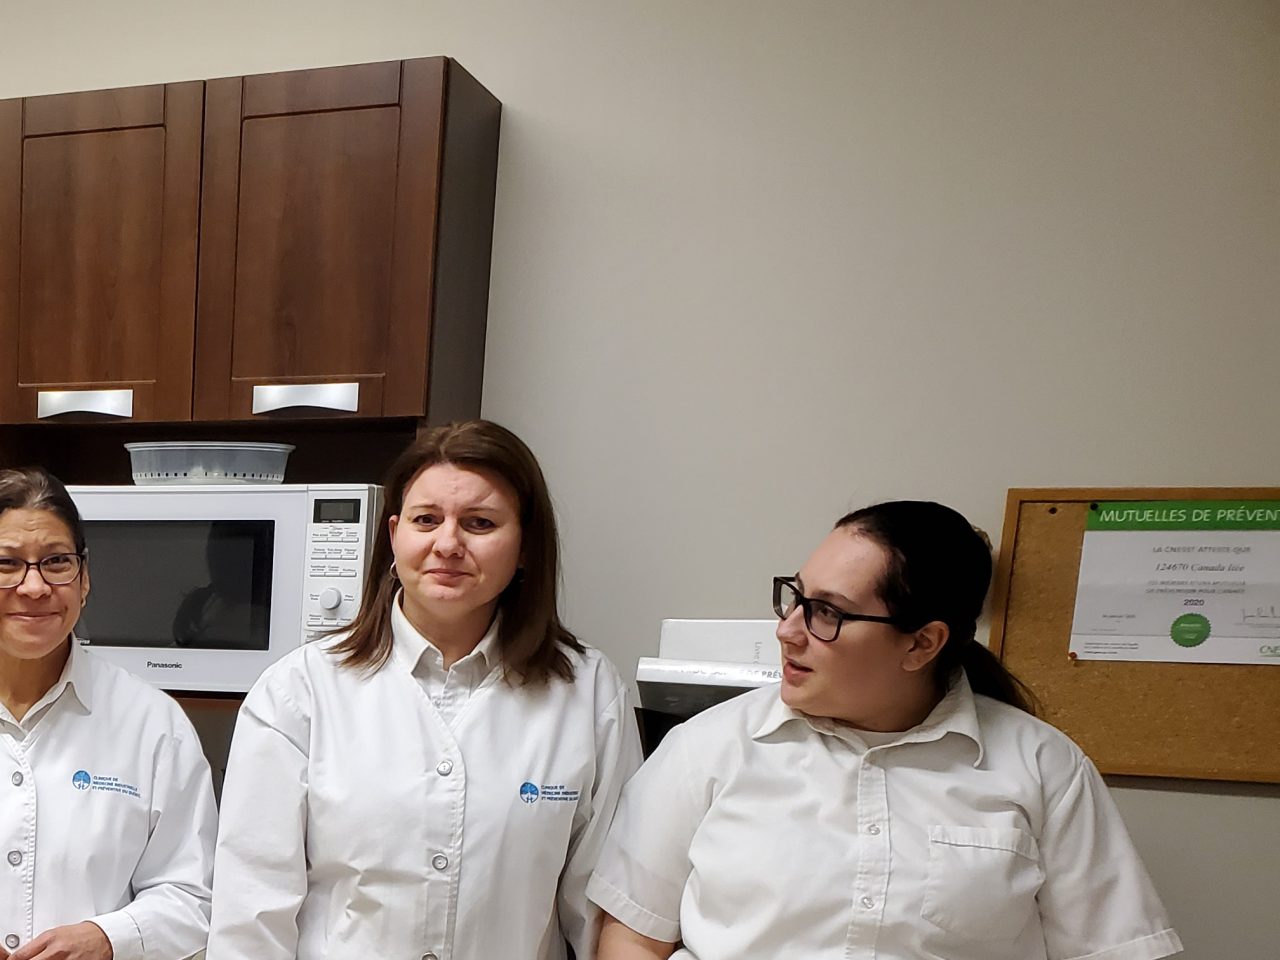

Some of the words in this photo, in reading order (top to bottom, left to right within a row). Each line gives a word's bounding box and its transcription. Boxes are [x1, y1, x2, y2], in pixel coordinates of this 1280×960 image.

[1099, 509, 1187, 522] MUTUELLES
[1191, 509, 1211, 522] DE
[1190, 563, 1226, 572] Canada
[146, 660, 183, 669] Panasonic
